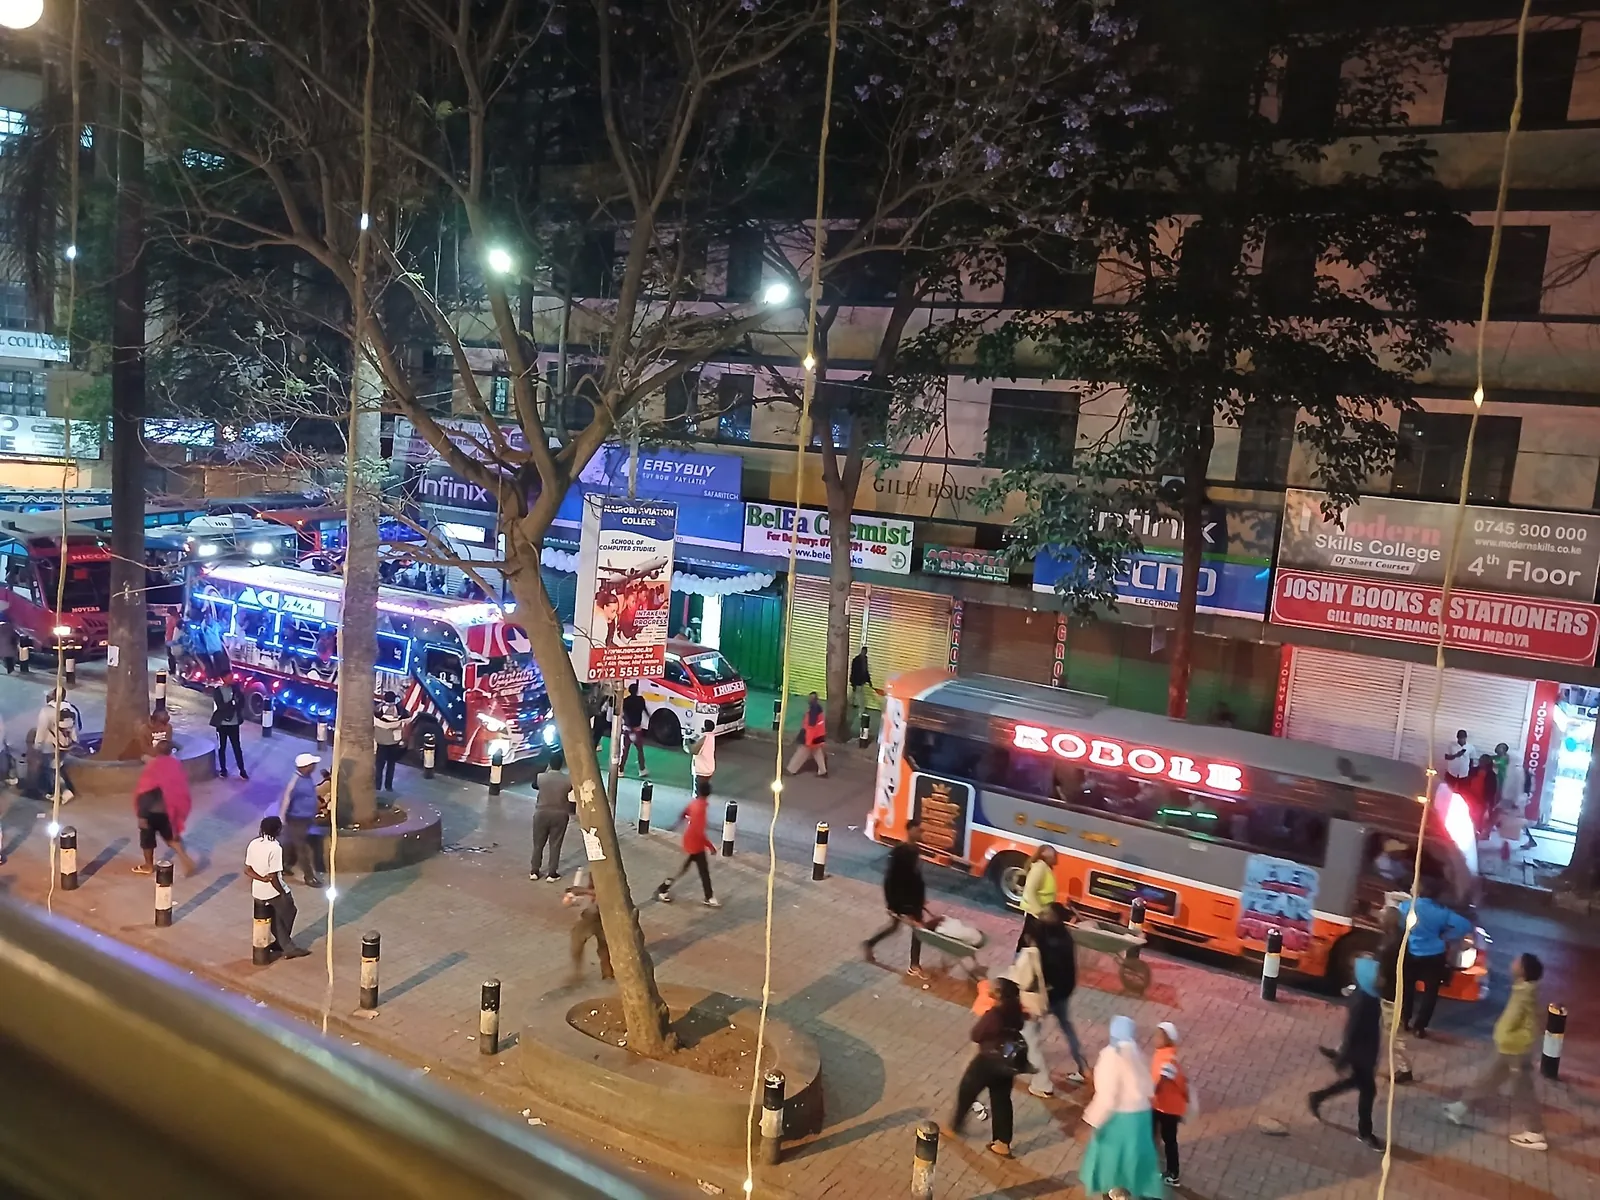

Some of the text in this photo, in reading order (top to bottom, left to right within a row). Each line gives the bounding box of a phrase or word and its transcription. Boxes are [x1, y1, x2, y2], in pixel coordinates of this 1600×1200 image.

[643, 459, 716, 477] EASYBUY
[688, 477, 707, 485] LATER
[873, 478, 986, 501] GILL HOUS
[703, 489, 739, 500] SAFARITECH
[603, 504, 675, 517] NAIROBI AVIATION
[621, 517, 657, 526] COLLEGE
[814, 510, 913, 548] Cemist
[1473, 519, 1588, 542] 0745 300 000
[598, 544, 657, 553] COMPUTER STUDIES
[611, 538, 635, 546] SCHOOL
[767, 530, 781, 541] For
[870, 544, 888, 555] 462
[1314, 533, 1442, 564] Skills College
[1474, 538, 1583, 555] www.modernskills.co.ke
[1334, 555, 1411, 573] Of Short Courses
[1506, 559, 1582, 587] Floor
[1087, 552, 1218, 598] ECNO
[1283, 577, 1590, 637] JOSHY BOOKS & STATIONERS
[633, 618, 668, 627] PROGRESS
[1326, 609, 1352, 625] GILL
[1353, 612, 1394, 630] HOUSE
[1452, 624, 1481, 641] TOM
[1482, 630, 1530, 648] MBOYA
[619, 666, 640, 677] 555
[643, 664, 664, 676] 558
[1278, 661, 1290, 701] JOSHY
[1532, 701, 1548, 742] JOSHY
